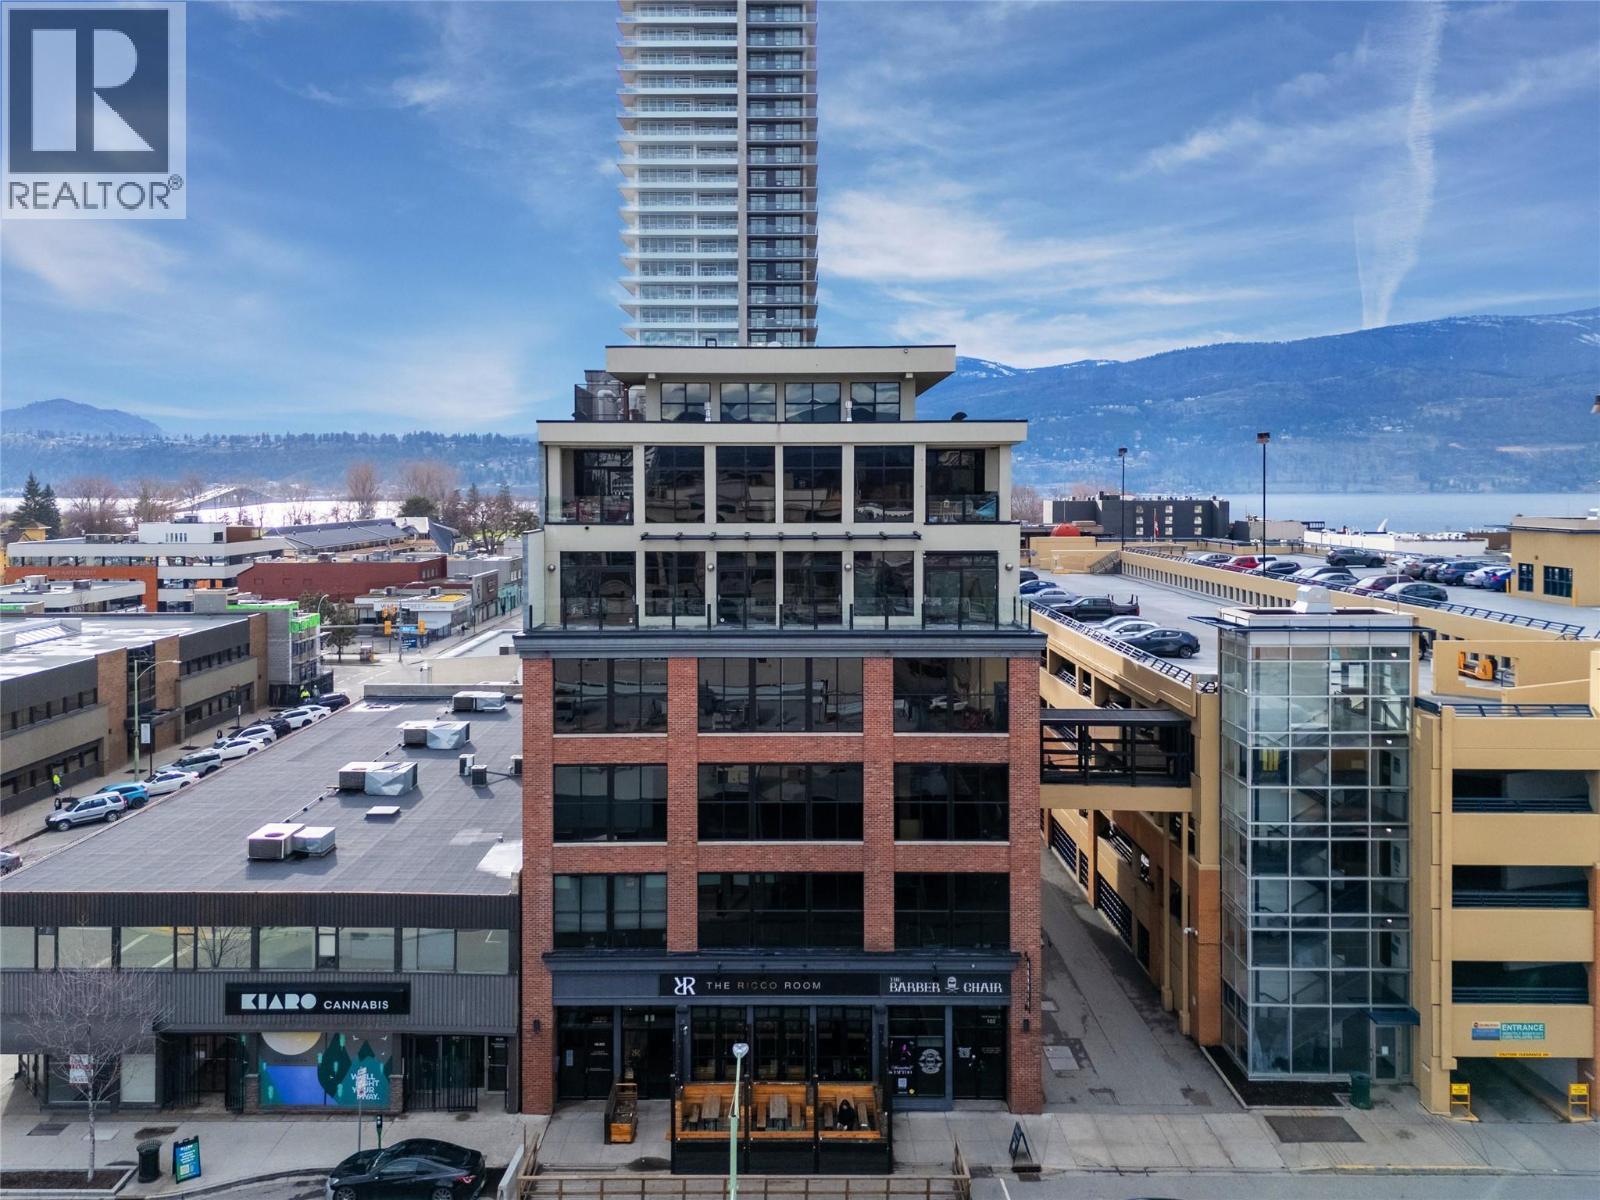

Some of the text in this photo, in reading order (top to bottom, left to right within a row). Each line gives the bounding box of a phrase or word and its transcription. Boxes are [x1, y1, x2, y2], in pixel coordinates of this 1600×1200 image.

[706, 981, 822, 990] THE RICCO ROOM
[889, 982, 1003, 993] BARBER CHAIR
[241, 993, 390, 1010] KIARO CANNABIS
